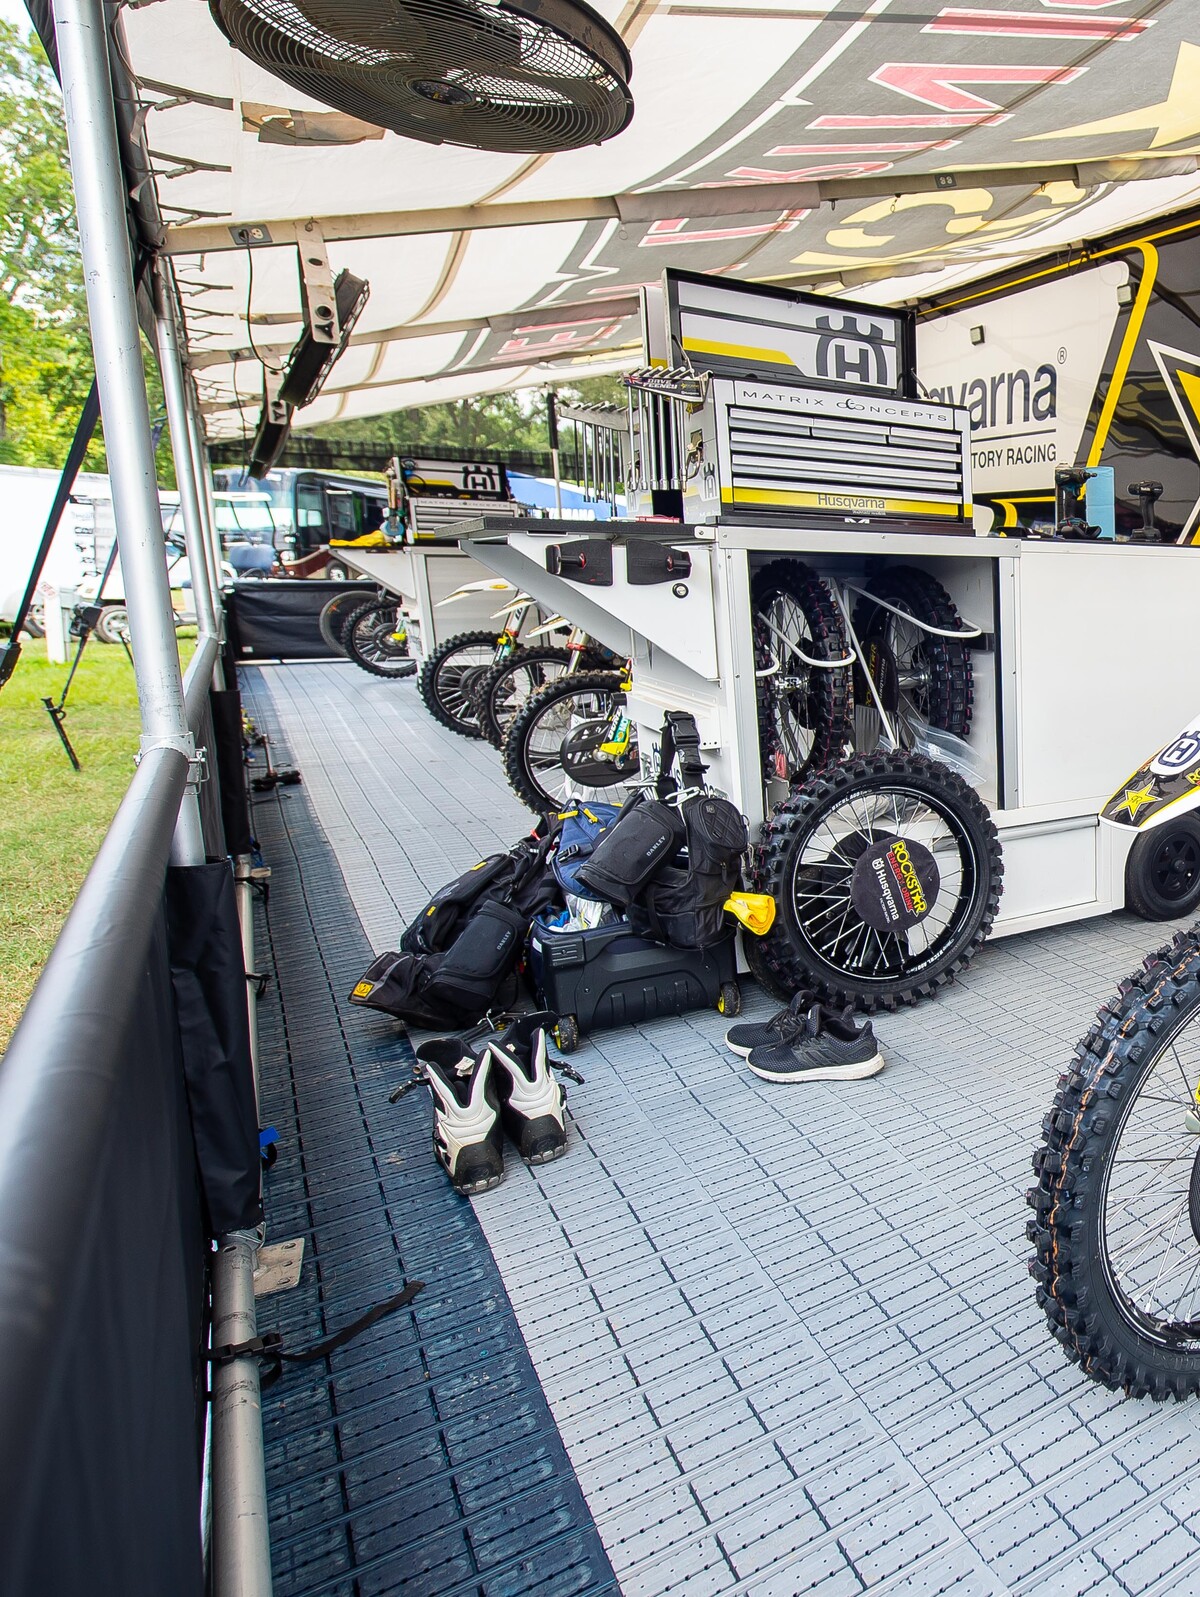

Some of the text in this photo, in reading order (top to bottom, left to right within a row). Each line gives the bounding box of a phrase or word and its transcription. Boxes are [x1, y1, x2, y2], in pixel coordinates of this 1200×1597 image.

[742, 389, 948, 423] MATRIX CONCEPTS
[1006, 443, 1057, 466] RACING
[817, 493, 885, 509] Husqvarna
[646, 835, 667, 857] OAKLEY
[887, 851, 913, 910] ENERGY DRINK
[892, 840, 927, 914] ROCKSTAR
[876, 869, 900, 920] Husqvarna
[496, 931, 511, 950] OAKLEY
